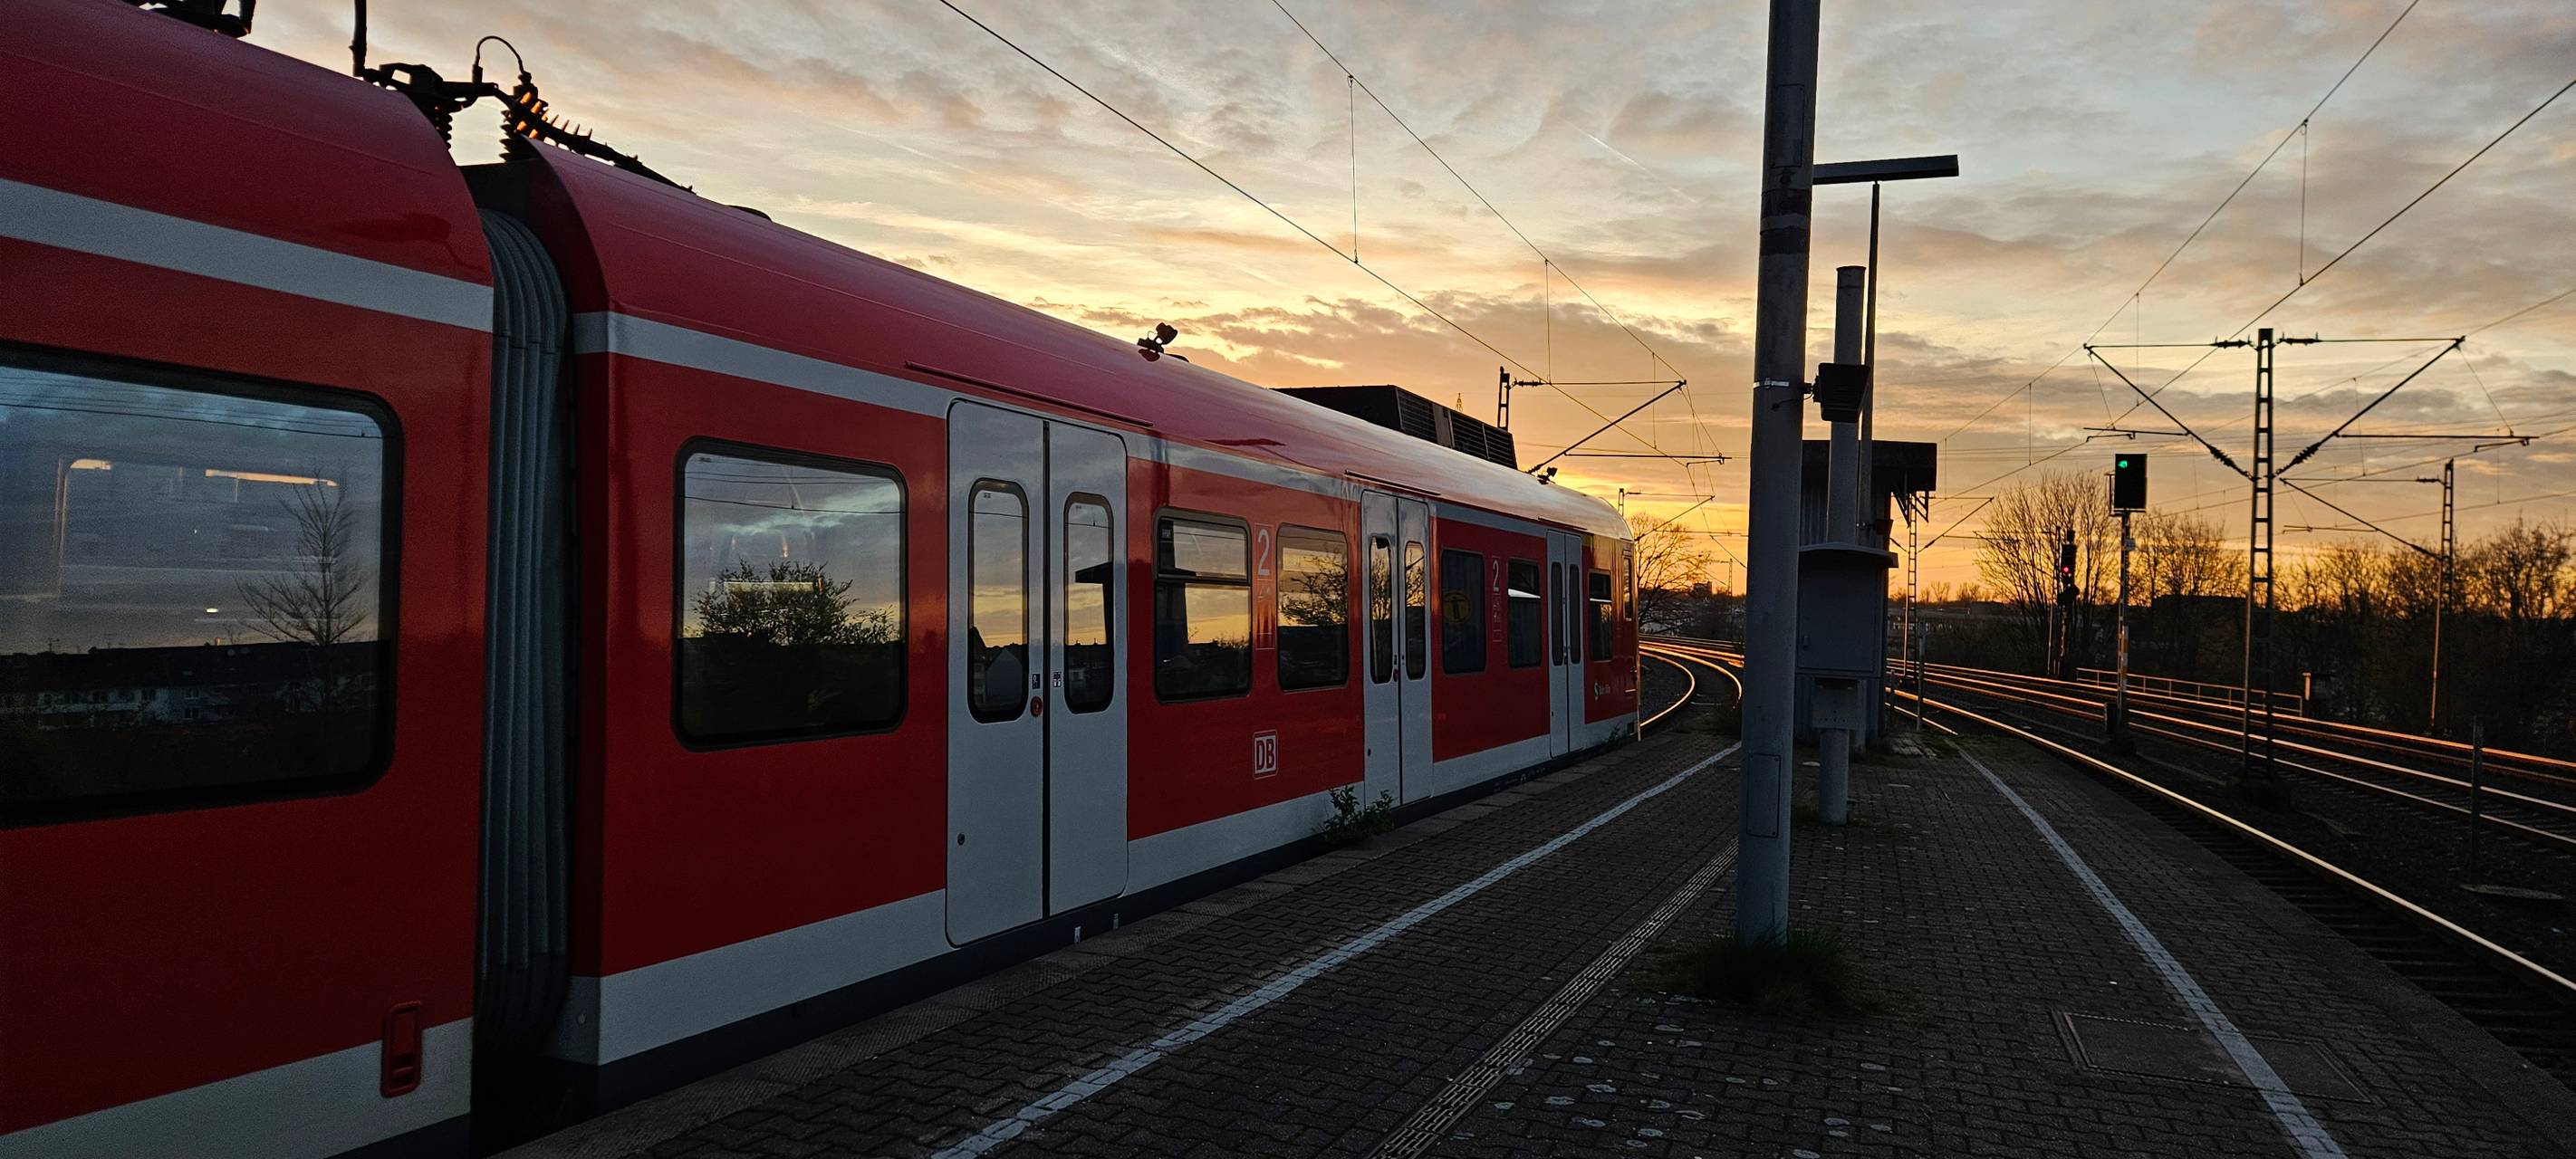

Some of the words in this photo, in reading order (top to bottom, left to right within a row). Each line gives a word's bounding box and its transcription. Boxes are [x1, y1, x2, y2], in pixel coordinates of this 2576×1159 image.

[1257, 528, 1270, 576] 2
[1493, 559, 1500, 592] 2
[1255, 737, 1275, 771] DB
